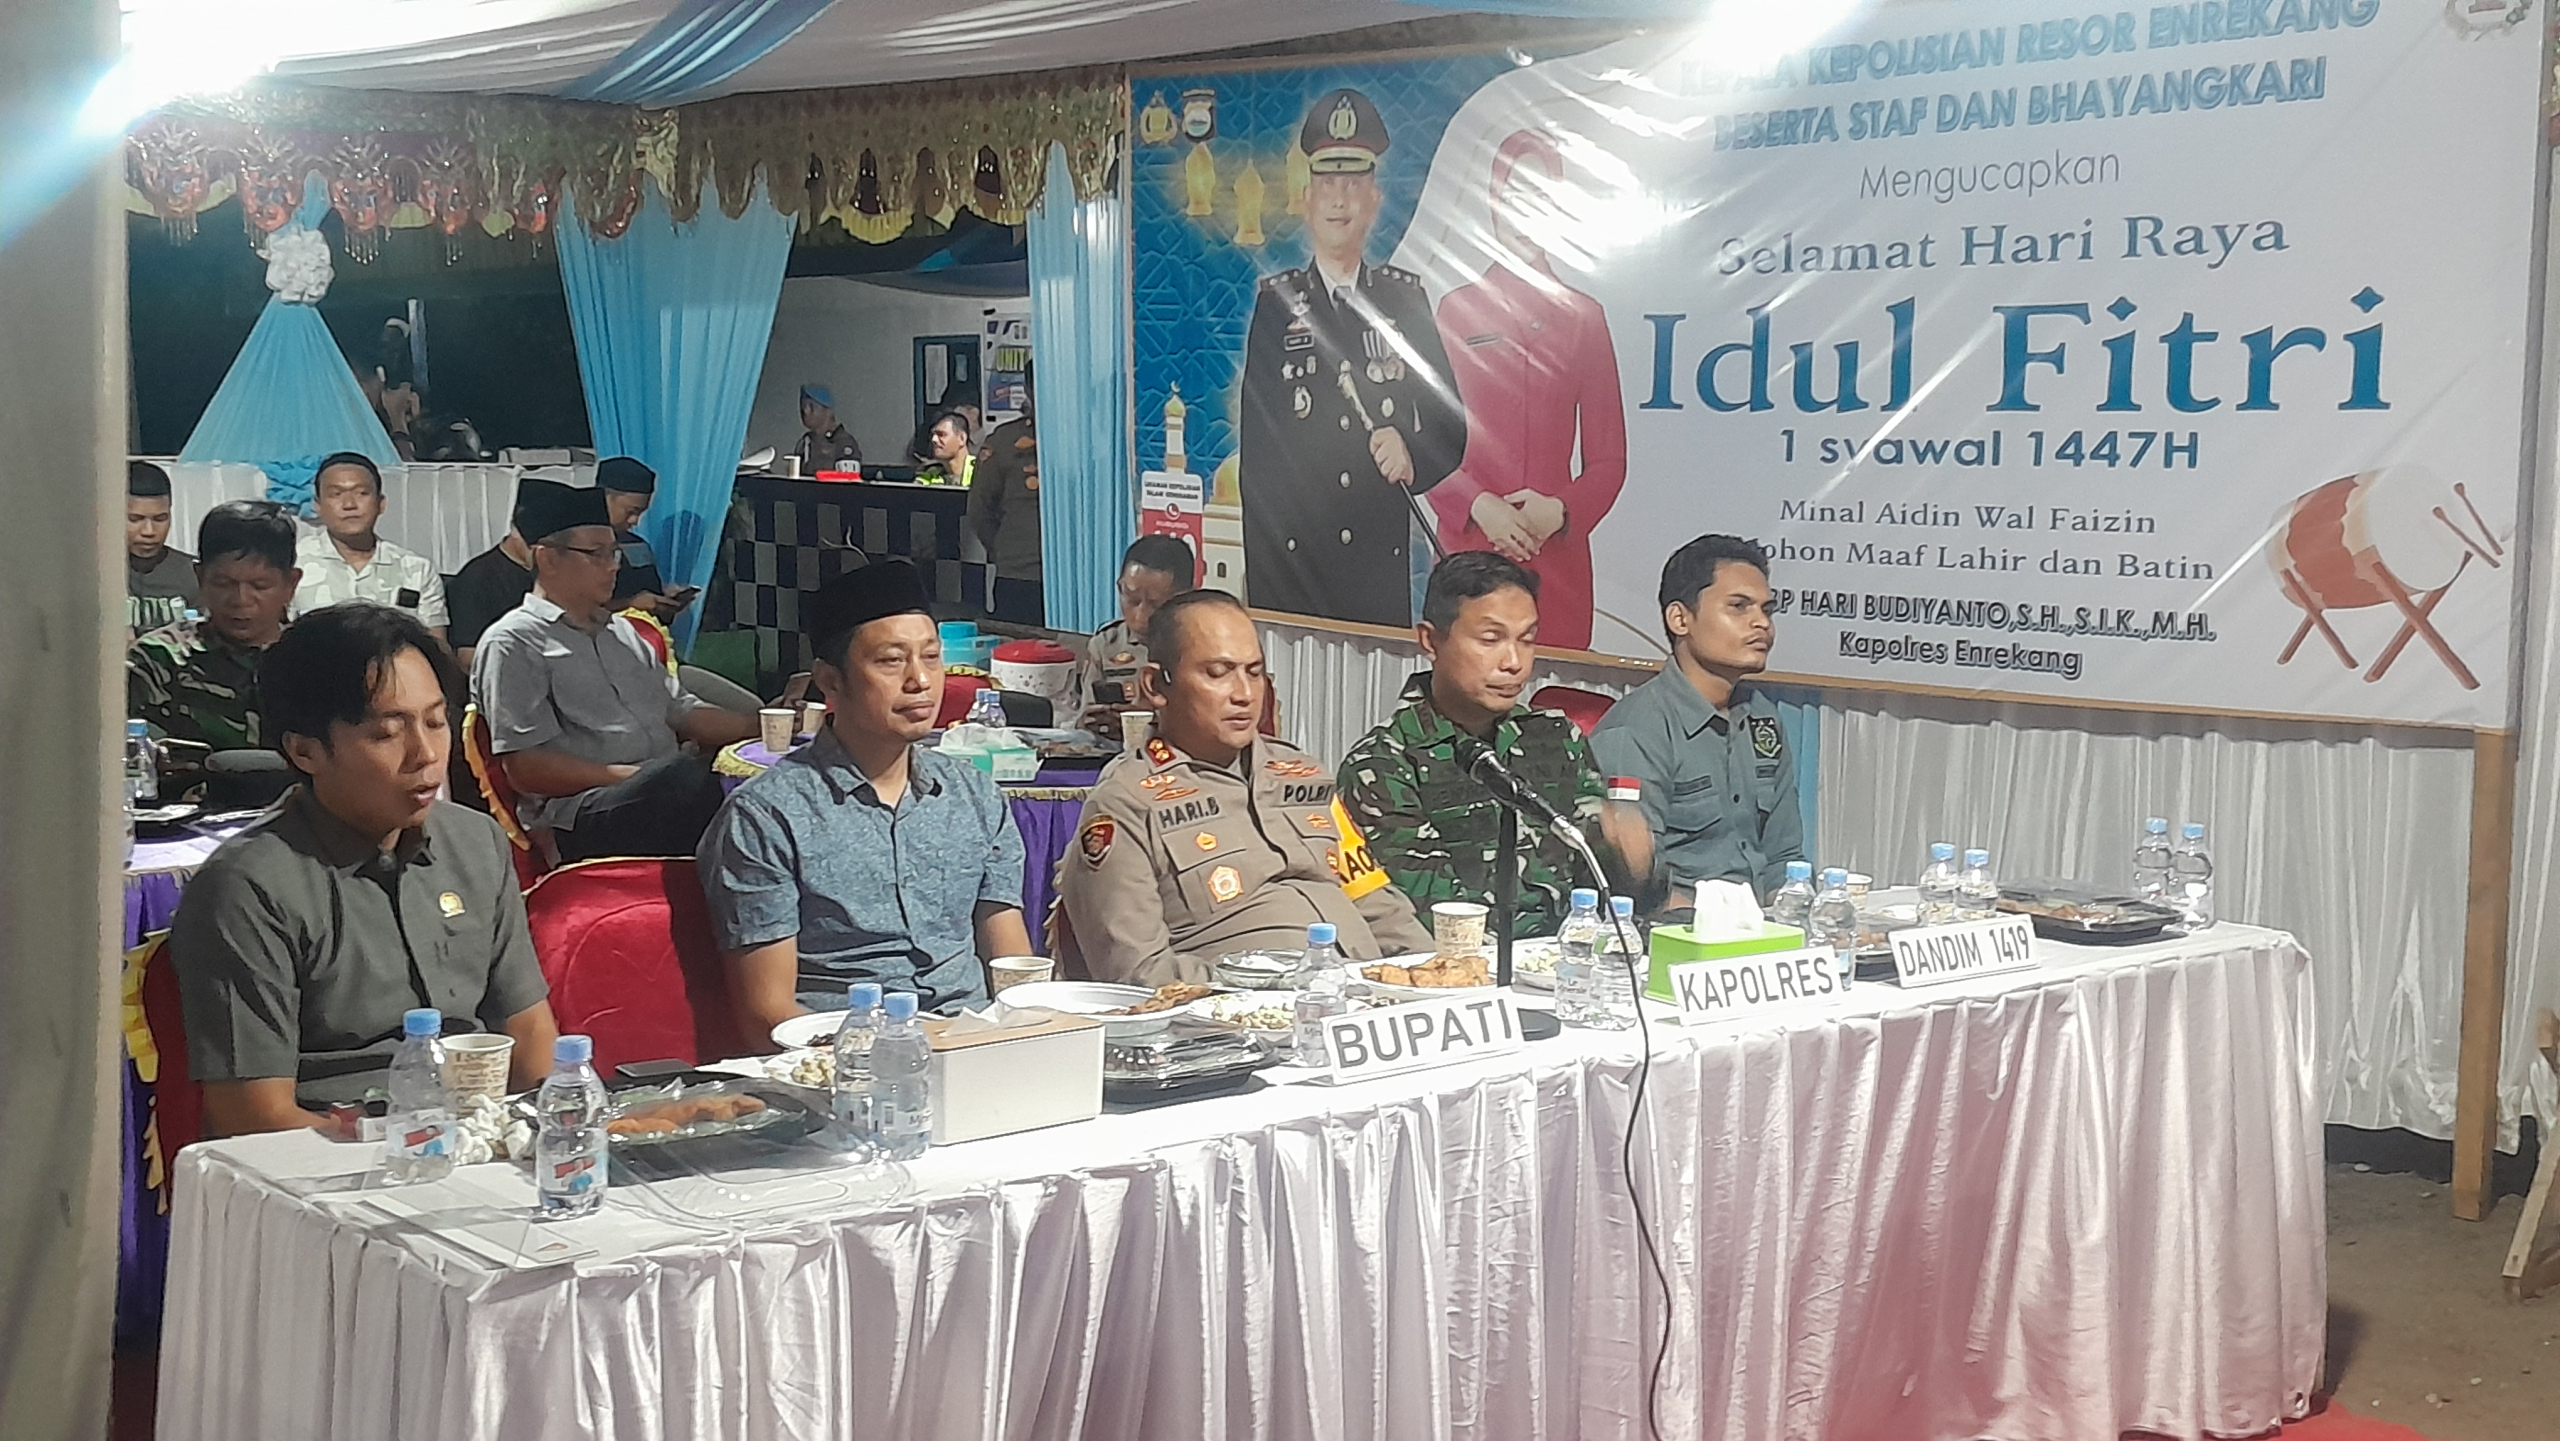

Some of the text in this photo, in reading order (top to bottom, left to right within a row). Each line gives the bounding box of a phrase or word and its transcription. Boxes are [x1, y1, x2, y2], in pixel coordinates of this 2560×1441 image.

[1680, 0, 2381, 96] KEALA KEPOLISIAN RESOR ENREKANG
[1713, 56, 2327, 151] BESERTA STAF DAN BHAYANGKARI
[1860, 149, 2120, 204] Mengucapkan
[1717, 214, 2290, 277] Selamat Hari Raya
[1638, 285, 2393, 414] Idul Fitri
[1780, 429, 1796, 463] 1
[2026, 429, 2199, 469] 1447H
[1780, 500, 2156, 534] Minal Aidin Wal Faizin
[1763, 538, 2214, 581] ohon Maaf Lahir dan Batin
[1800, 590, 1859, 619] HARI
[1839, 630, 2083, 680] Kapolres Enrekang
[1158, 796, 1221, 829] HARI.B
[1899, 924, 2030, 977] DANDIM 1419
[1679, 956, 1834, 1013] KAPOLRES
[1331, 998, 1512, 1069] BUPATI
